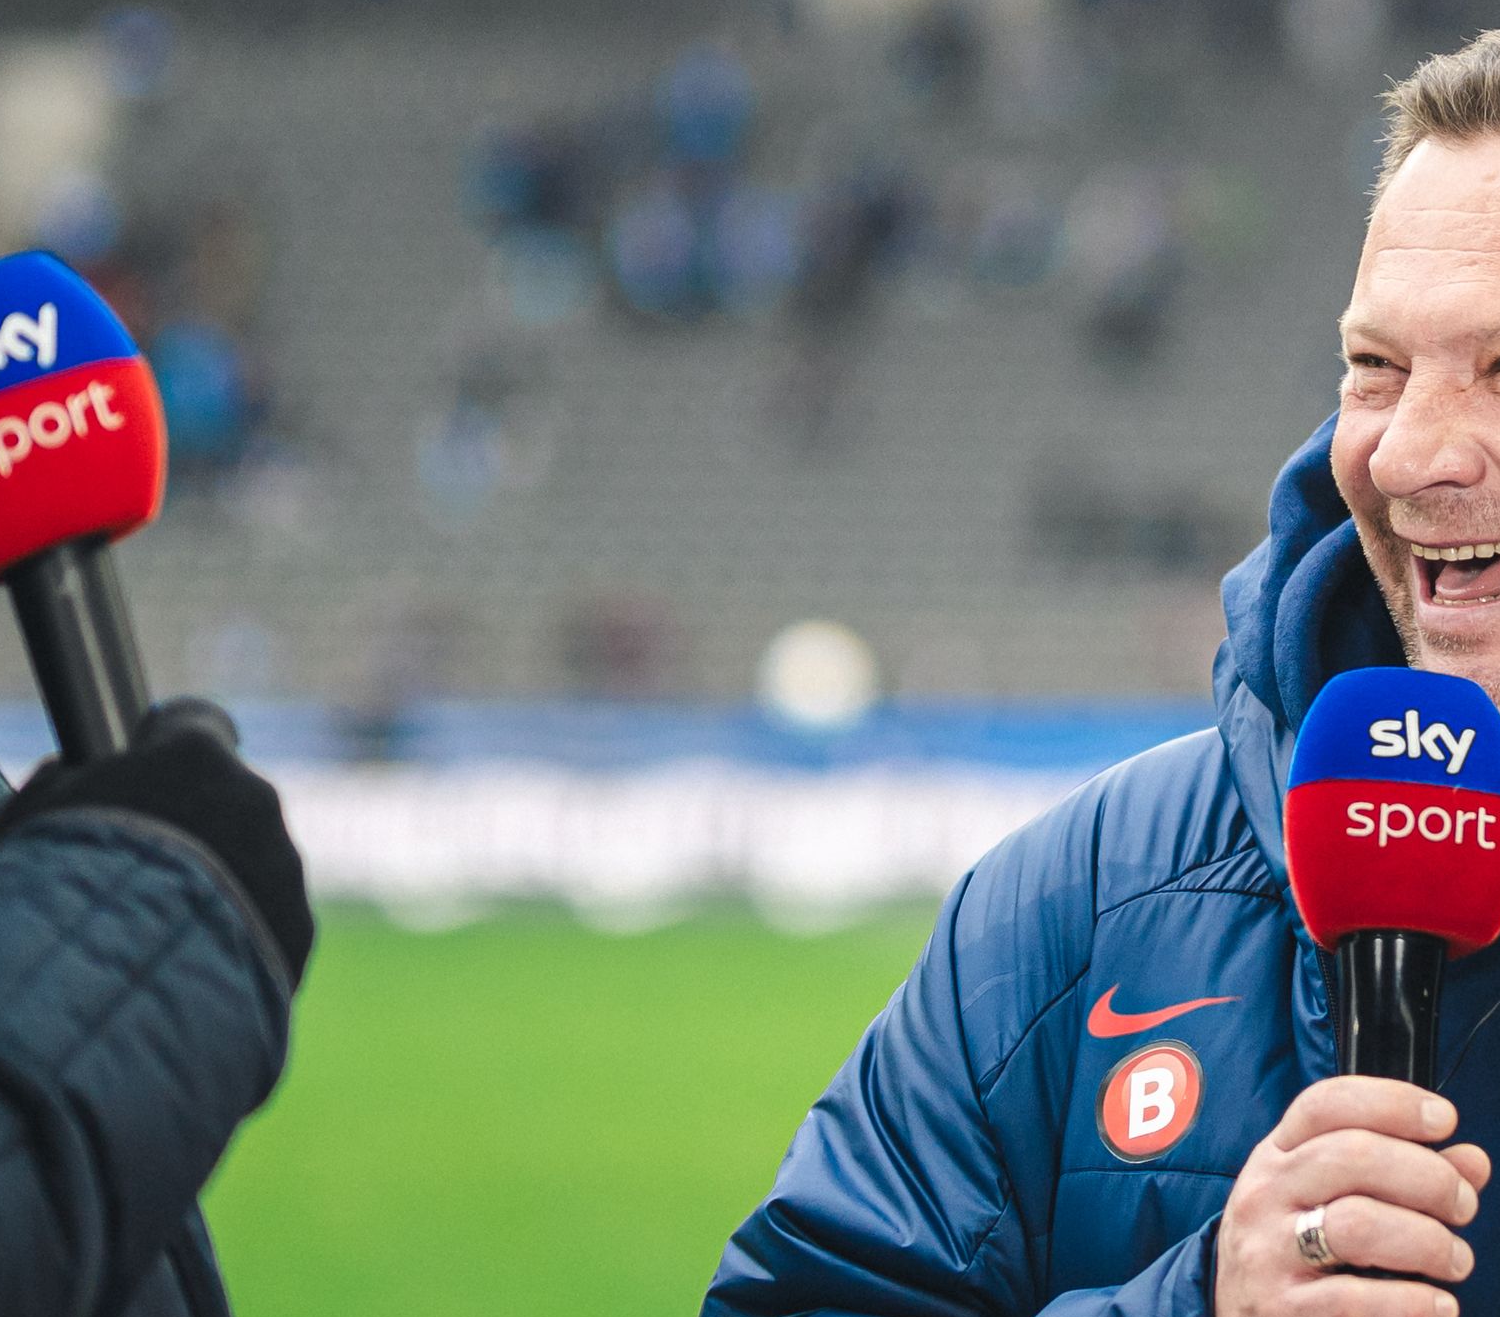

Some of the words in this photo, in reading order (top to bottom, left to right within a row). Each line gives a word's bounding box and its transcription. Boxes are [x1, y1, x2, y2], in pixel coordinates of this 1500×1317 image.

[1369, 709, 1476, 775] sky
[1346, 801, 1497, 850] sport
[1128, 1067, 1176, 1140] B
